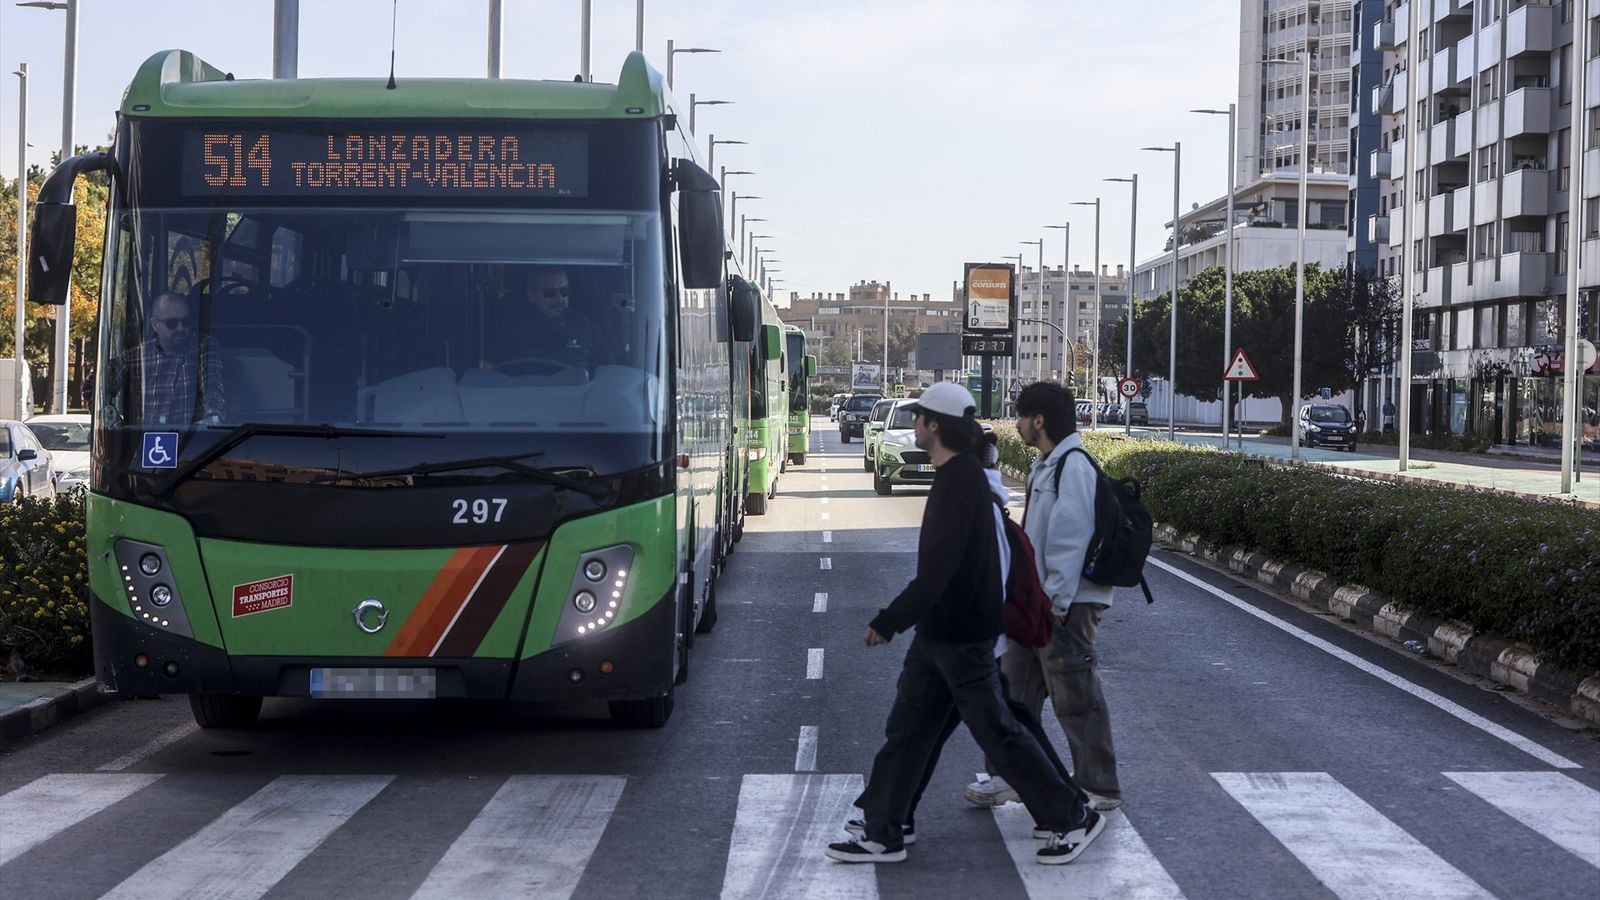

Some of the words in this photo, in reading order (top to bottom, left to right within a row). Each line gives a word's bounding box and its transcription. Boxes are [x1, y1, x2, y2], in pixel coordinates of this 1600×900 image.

[327, 135, 519, 161] LANZADERA
[204, 134, 272, 187] 514
[290, 162, 555, 188] TORRENT-VALENCIA
[1123, 384, 1136, 392] 30
[452, 498, 508, 524] 297
[239, 587, 289, 605] TRANSPORTES
[249, 578, 289, 593] CONSORCIO
[261, 596, 288, 609] MADRID
